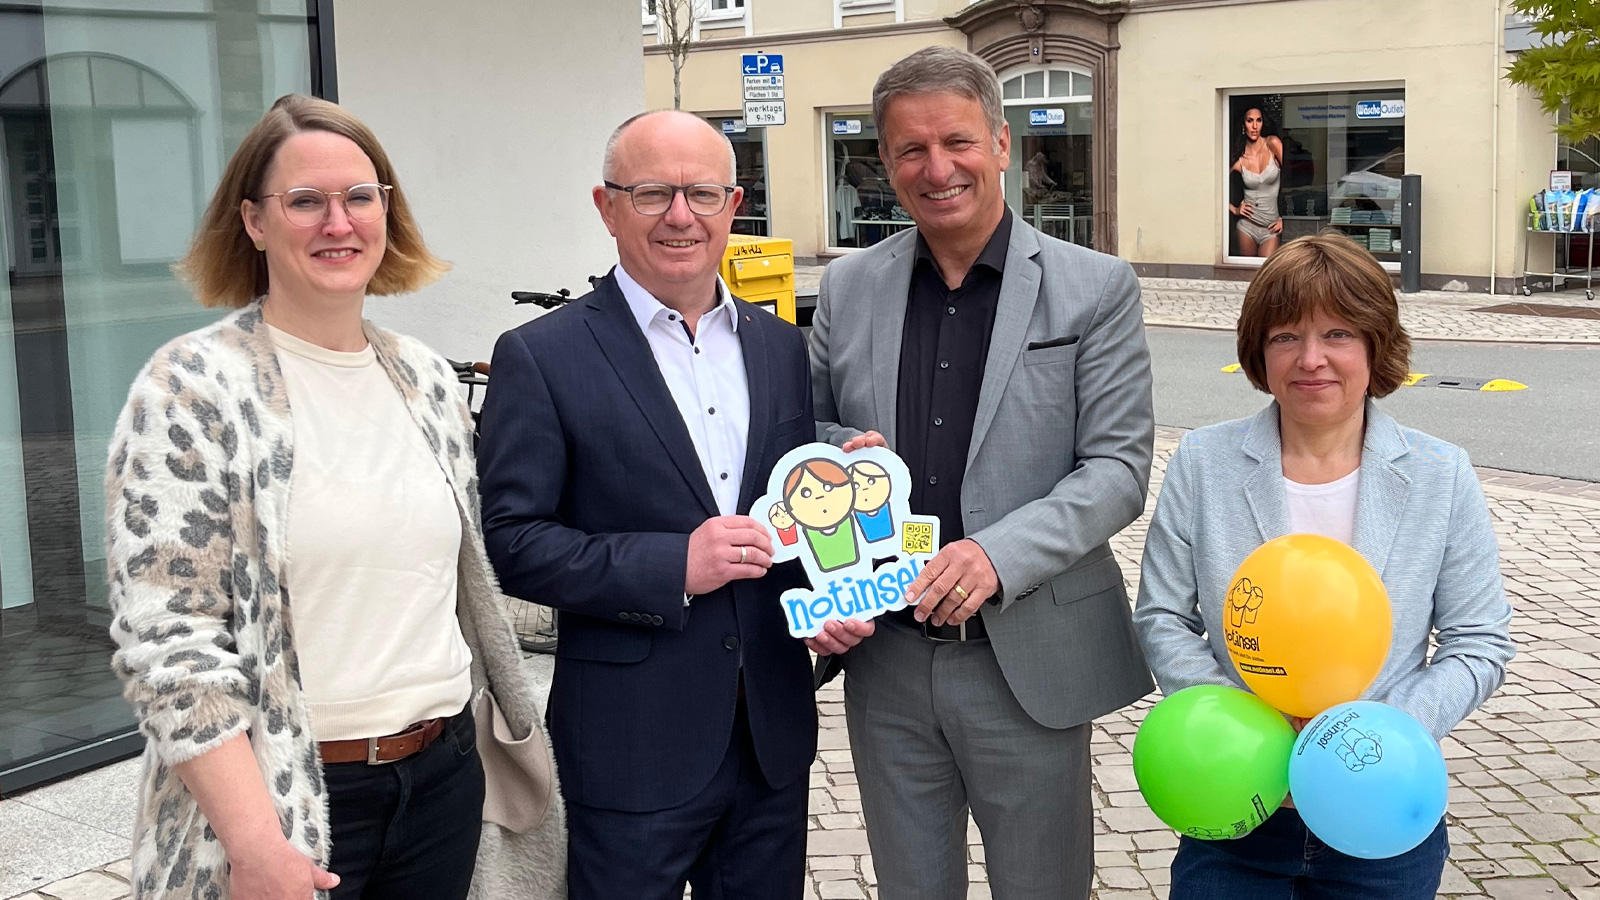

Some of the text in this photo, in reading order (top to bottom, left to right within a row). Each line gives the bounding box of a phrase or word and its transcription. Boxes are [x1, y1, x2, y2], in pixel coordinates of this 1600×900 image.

[757, 55, 769, 73] P
[748, 105, 783, 114] werktags
[1381, 104, 1404, 114] Outlet
[1047, 113, 1063, 121] Outlet
[786, 558, 920, 631] notinsel
[1317, 711, 1360, 749] notinsel
